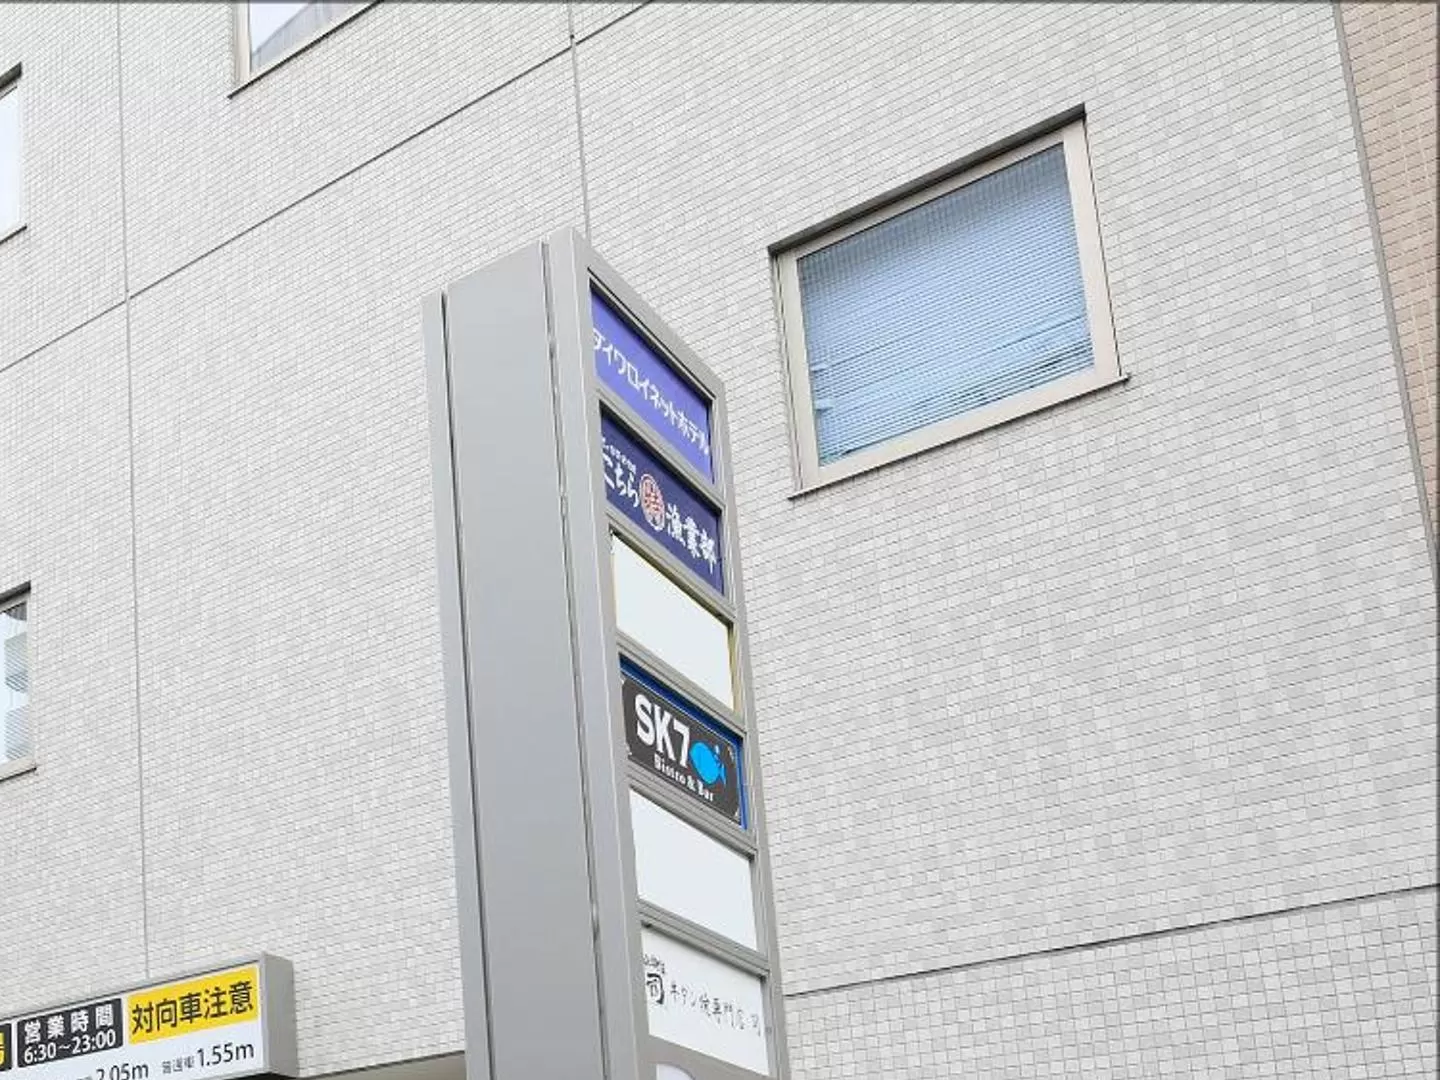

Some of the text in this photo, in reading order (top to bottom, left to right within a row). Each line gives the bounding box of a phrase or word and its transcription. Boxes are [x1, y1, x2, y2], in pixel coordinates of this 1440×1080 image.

[635, 694, 690, 768] SK7
[24, 1003, 114, 1045] 営業時間
[131, 980, 254, 1035] 対向車注意
